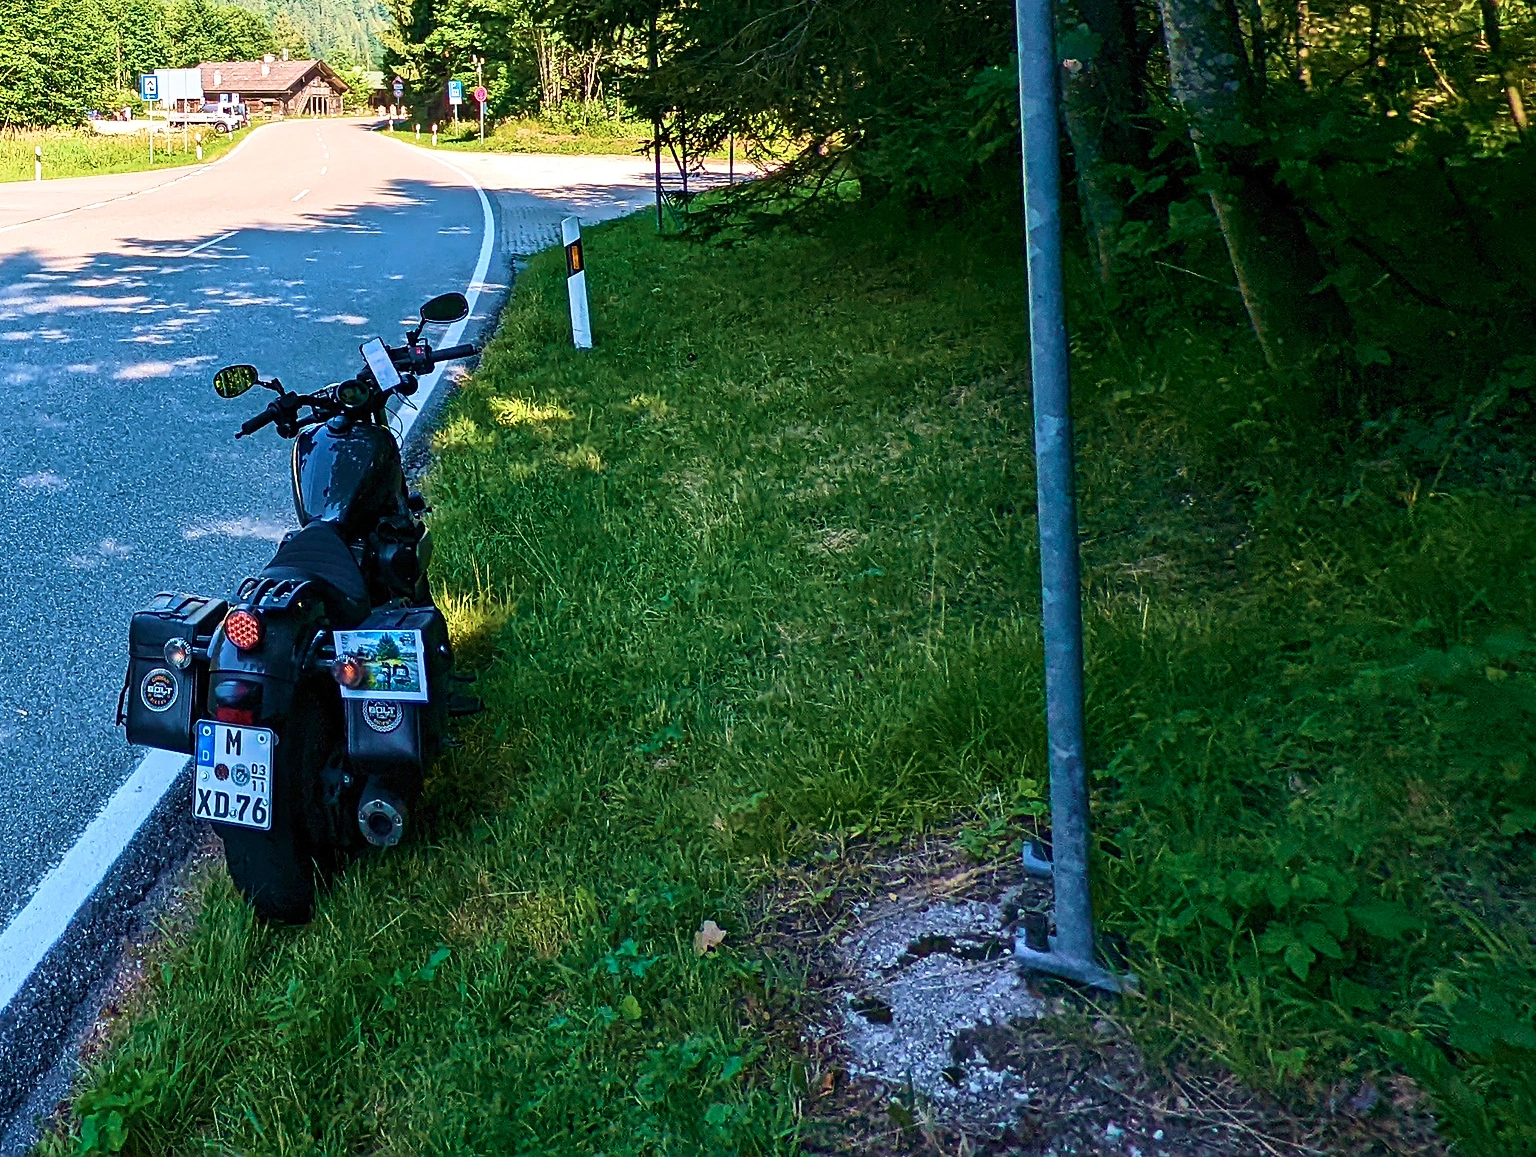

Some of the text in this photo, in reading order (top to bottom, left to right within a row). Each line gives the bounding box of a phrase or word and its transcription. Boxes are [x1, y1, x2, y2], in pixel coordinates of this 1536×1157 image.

[147, 685, 173, 695] BOLT
[368, 706, 396, 715] BOLT
[226, 728, 243, 756] M
[202, 750, 211, 762] D
[251, 763, 267, 776] 03
[252, 780, 266, 793] 11
[196, 788, 268, 825] XD 76
